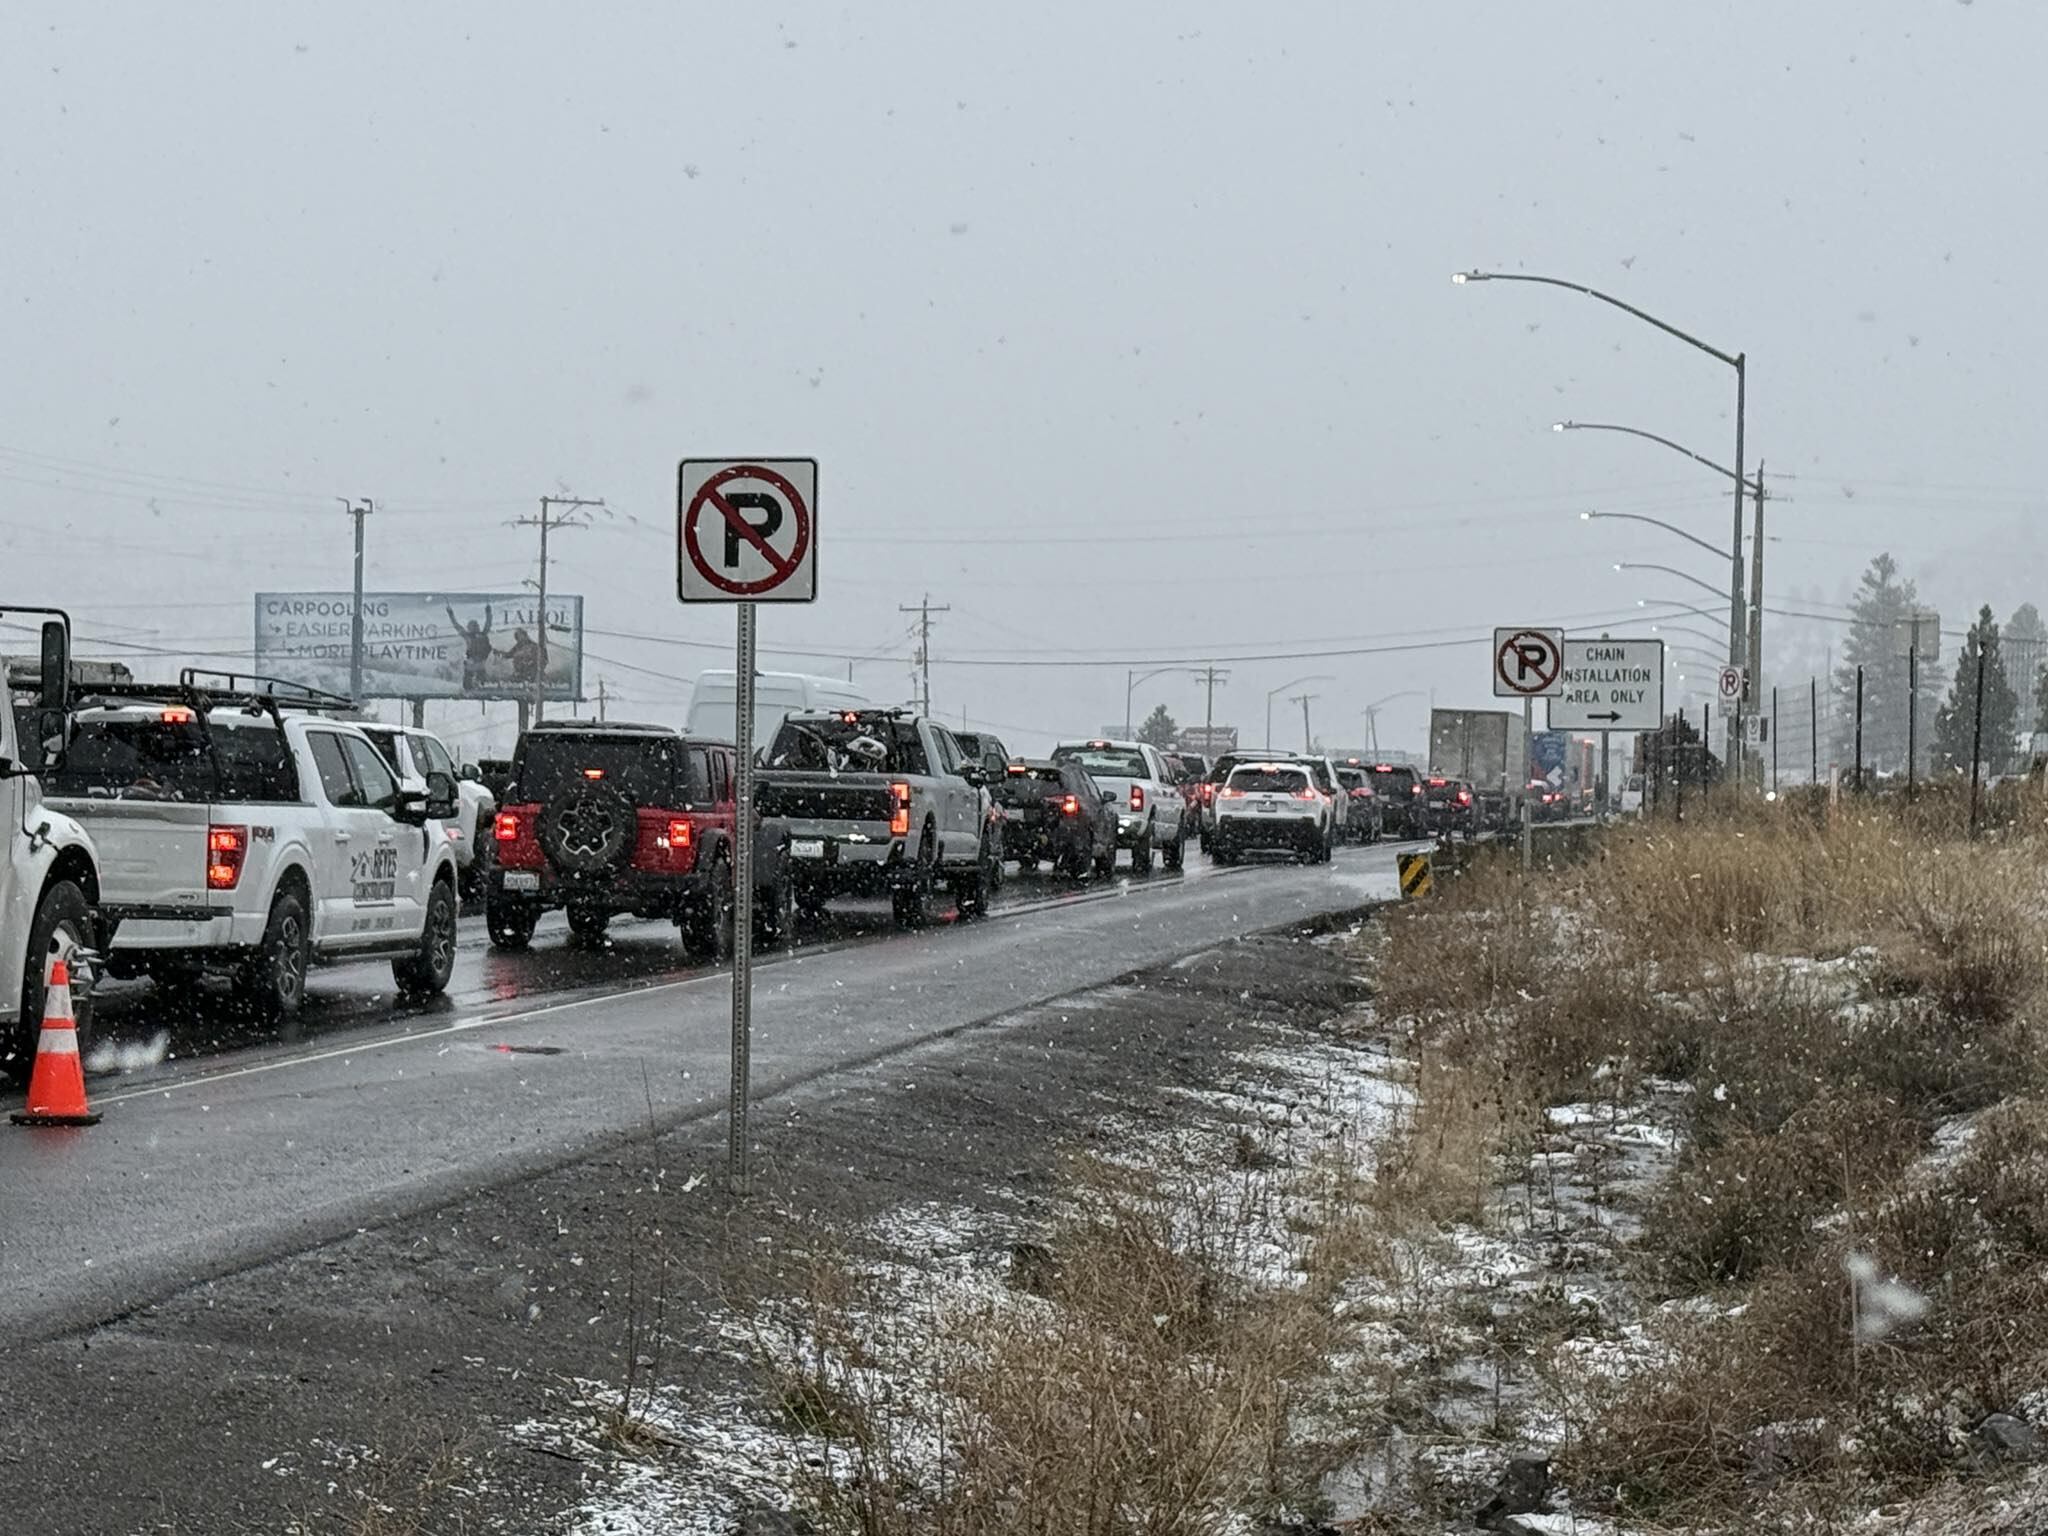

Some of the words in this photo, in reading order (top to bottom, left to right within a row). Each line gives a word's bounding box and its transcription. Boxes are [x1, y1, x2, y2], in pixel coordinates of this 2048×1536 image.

[724, 493, 783, 568] P
[267, 601, 390, 617] CARPOOLNG
[287, 622, 352, 638] EASIER
[363, 623, 438, 638] ARKING
[298, 644, 352, 659] MORE
[1586, 647, 1625, 661] CHAIN
[1517, 644, 1547, 680] P
[1564, 668, 1651, 683] NSTALLATION
[1566, 689, 1600, 704] AREA
[1611, 689, 1645, 704] ONLY
